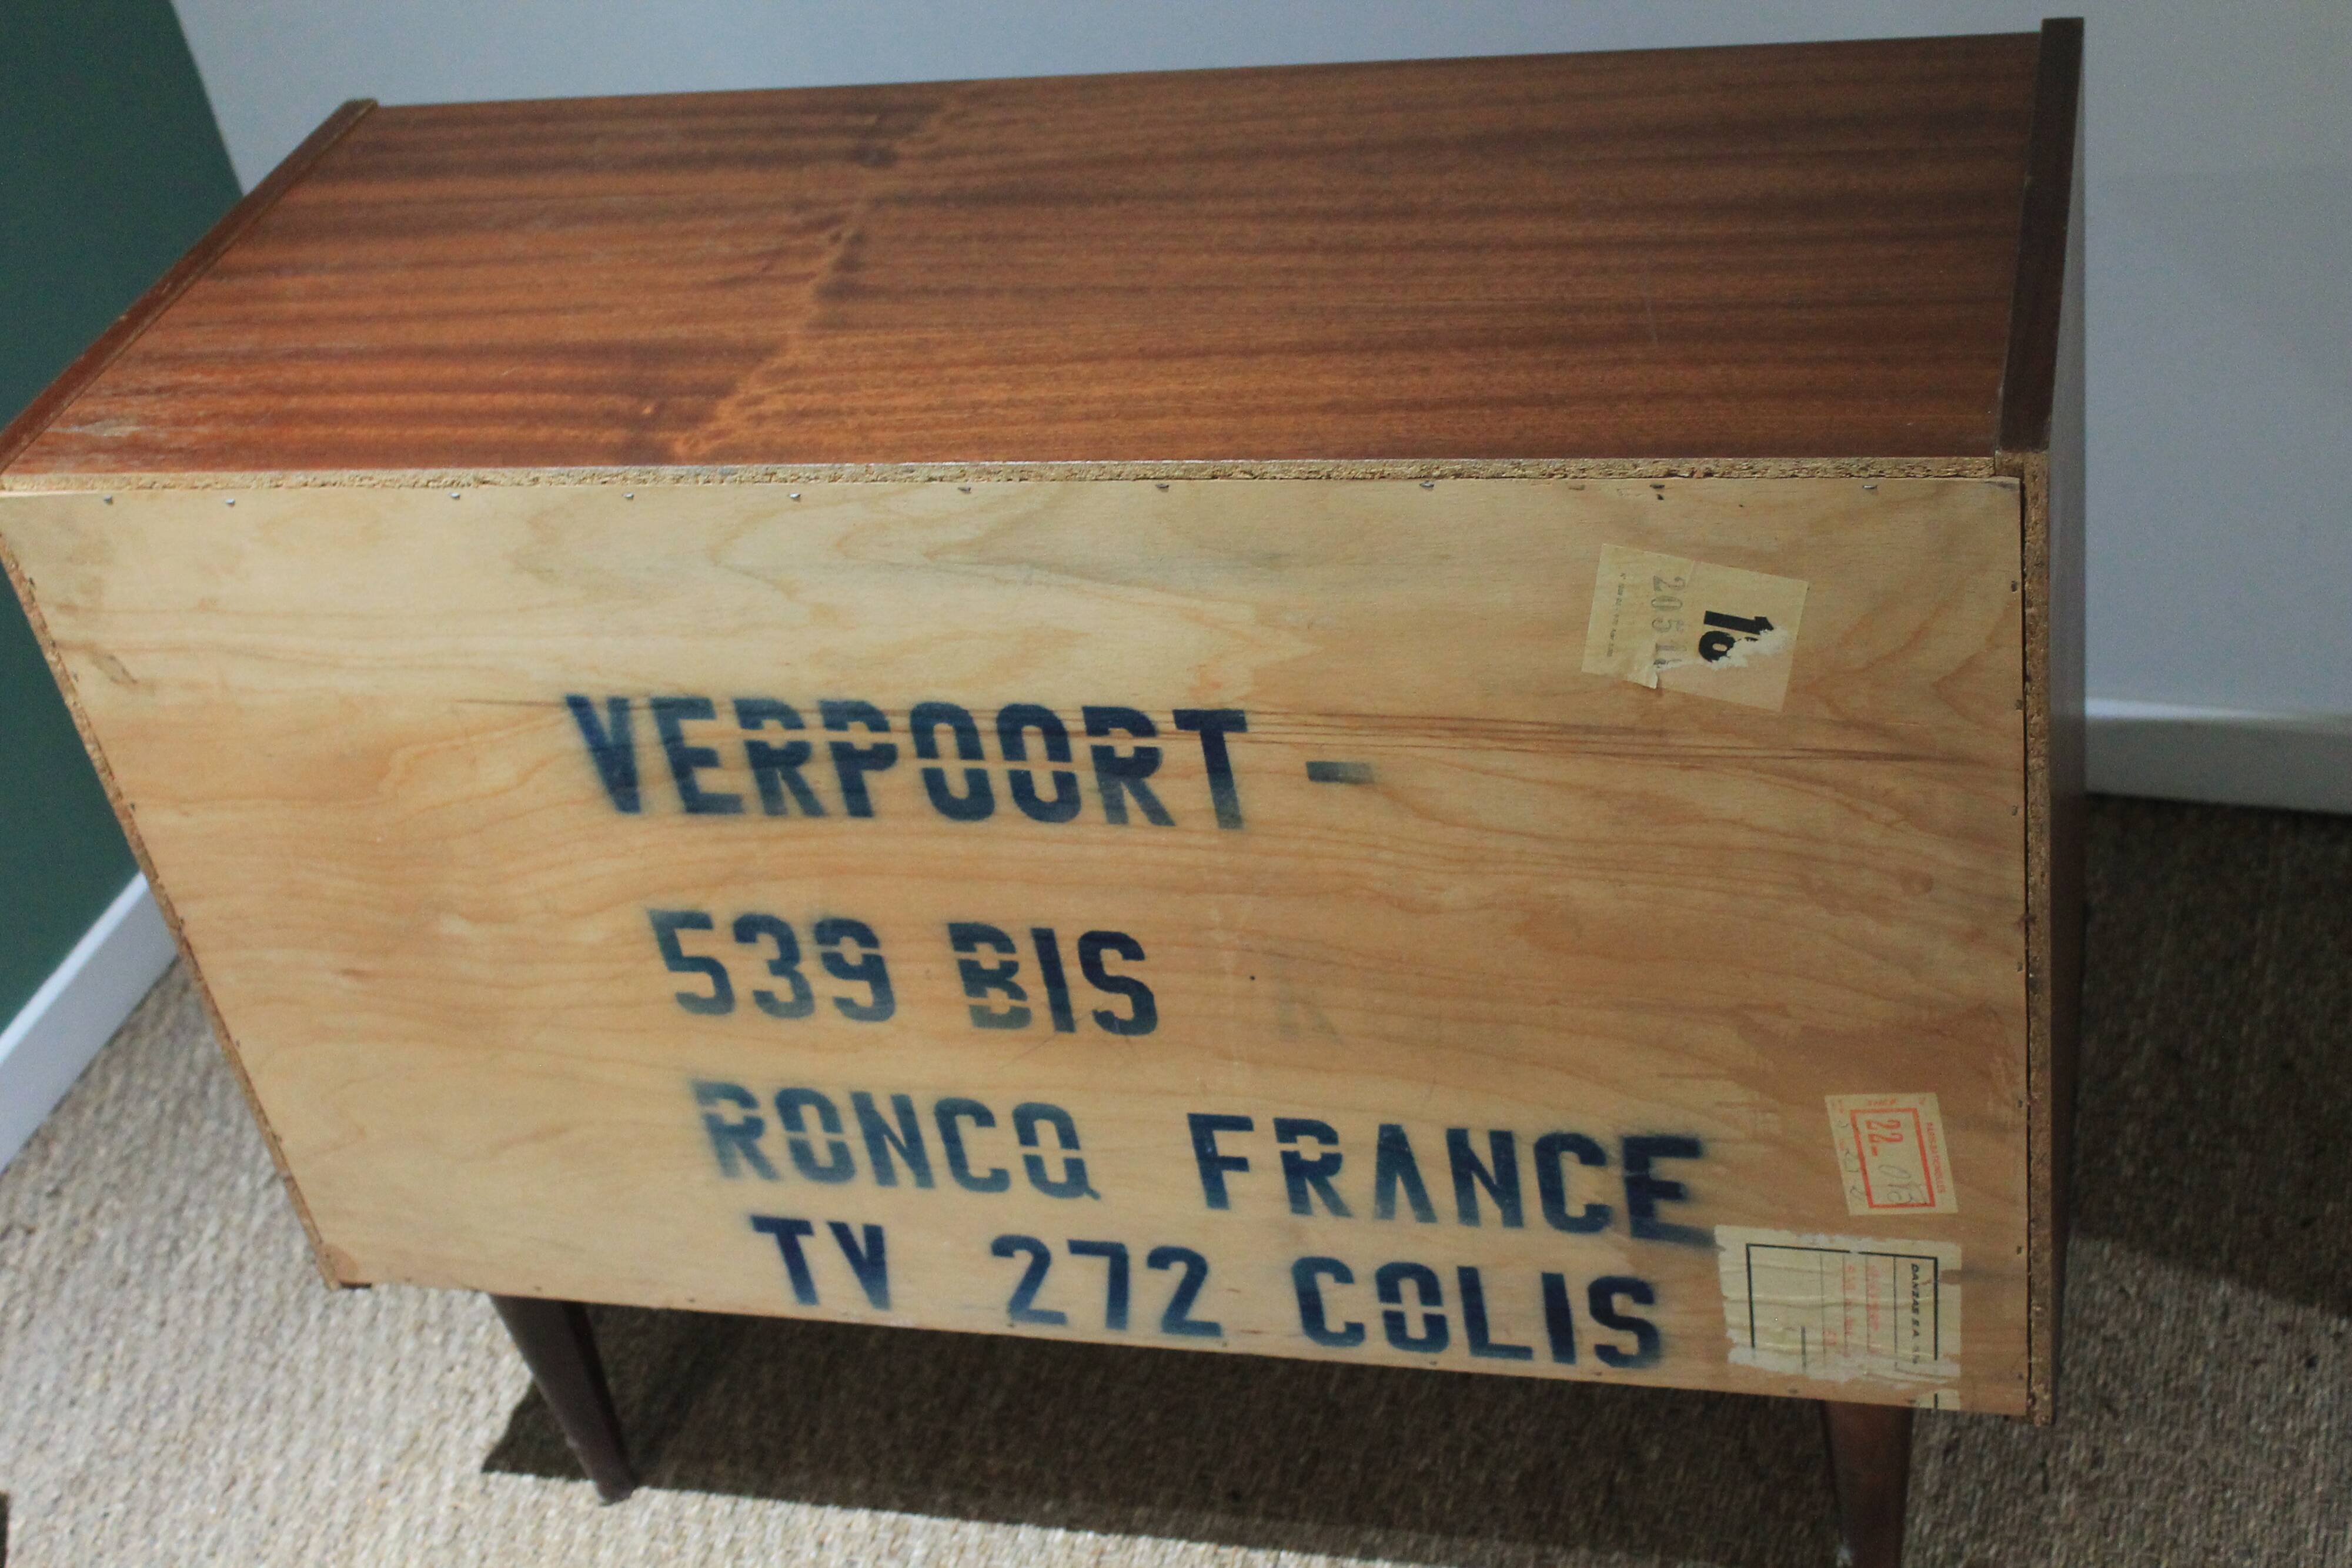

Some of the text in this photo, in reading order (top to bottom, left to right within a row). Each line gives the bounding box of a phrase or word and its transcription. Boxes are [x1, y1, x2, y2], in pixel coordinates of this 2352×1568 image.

[564, 693, 1248, 829] VERPOORT
[648, 909, 896, 1022] 539
[947, 922, 1158, 1036] BIS
[690, 1079, 1101, 1201] RONCQ
[1187, 1113, 1714, 1248] FRANCE
[749, 1213, 1664, 1370] TV 272 COLIS
[1911, 1263, 1920, 1313] DANZAS
